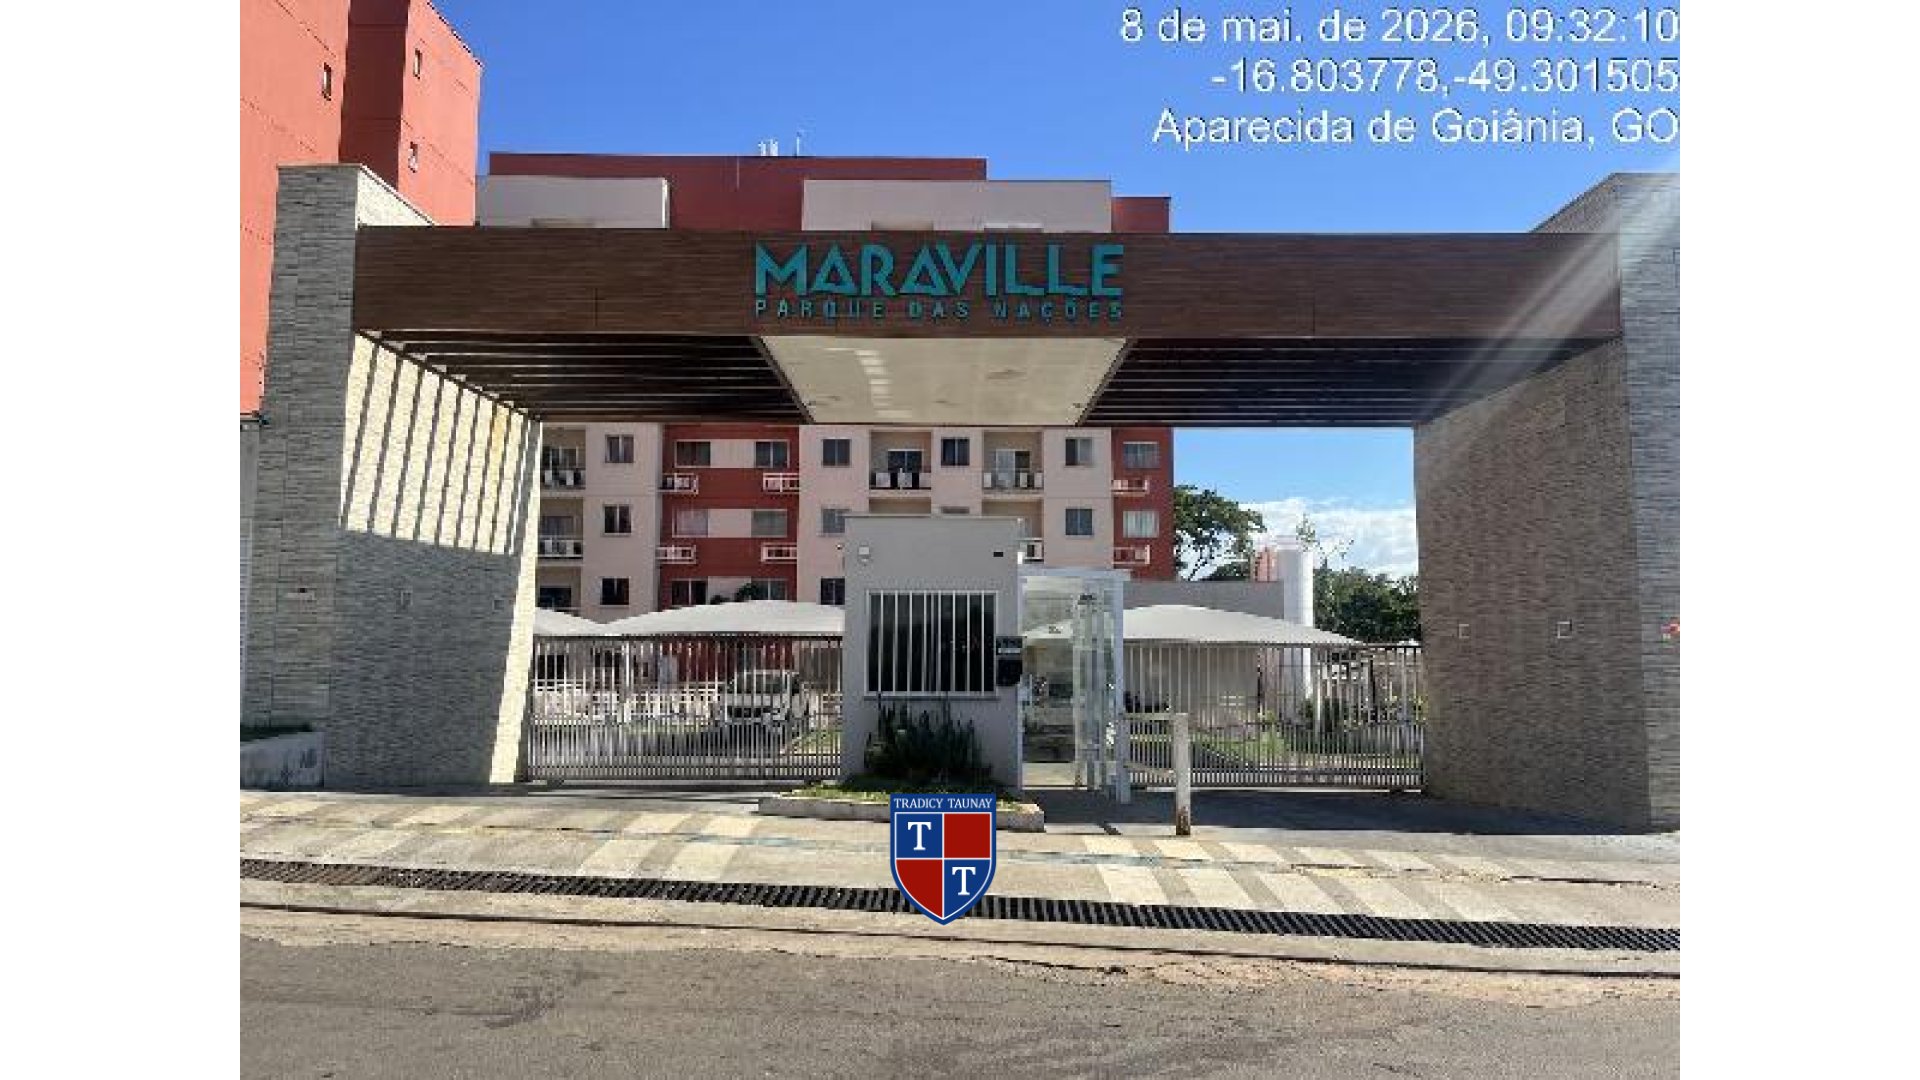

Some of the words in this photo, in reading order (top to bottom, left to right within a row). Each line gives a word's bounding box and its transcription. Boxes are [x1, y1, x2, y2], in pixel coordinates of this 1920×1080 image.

[754, 242, 1125, 297] MARAVILLE
[754, 300, 888, 319] PARQUE
[910, 300, 970, 319] DAS
[994, 299, 1124, 326] NAÇÕES
